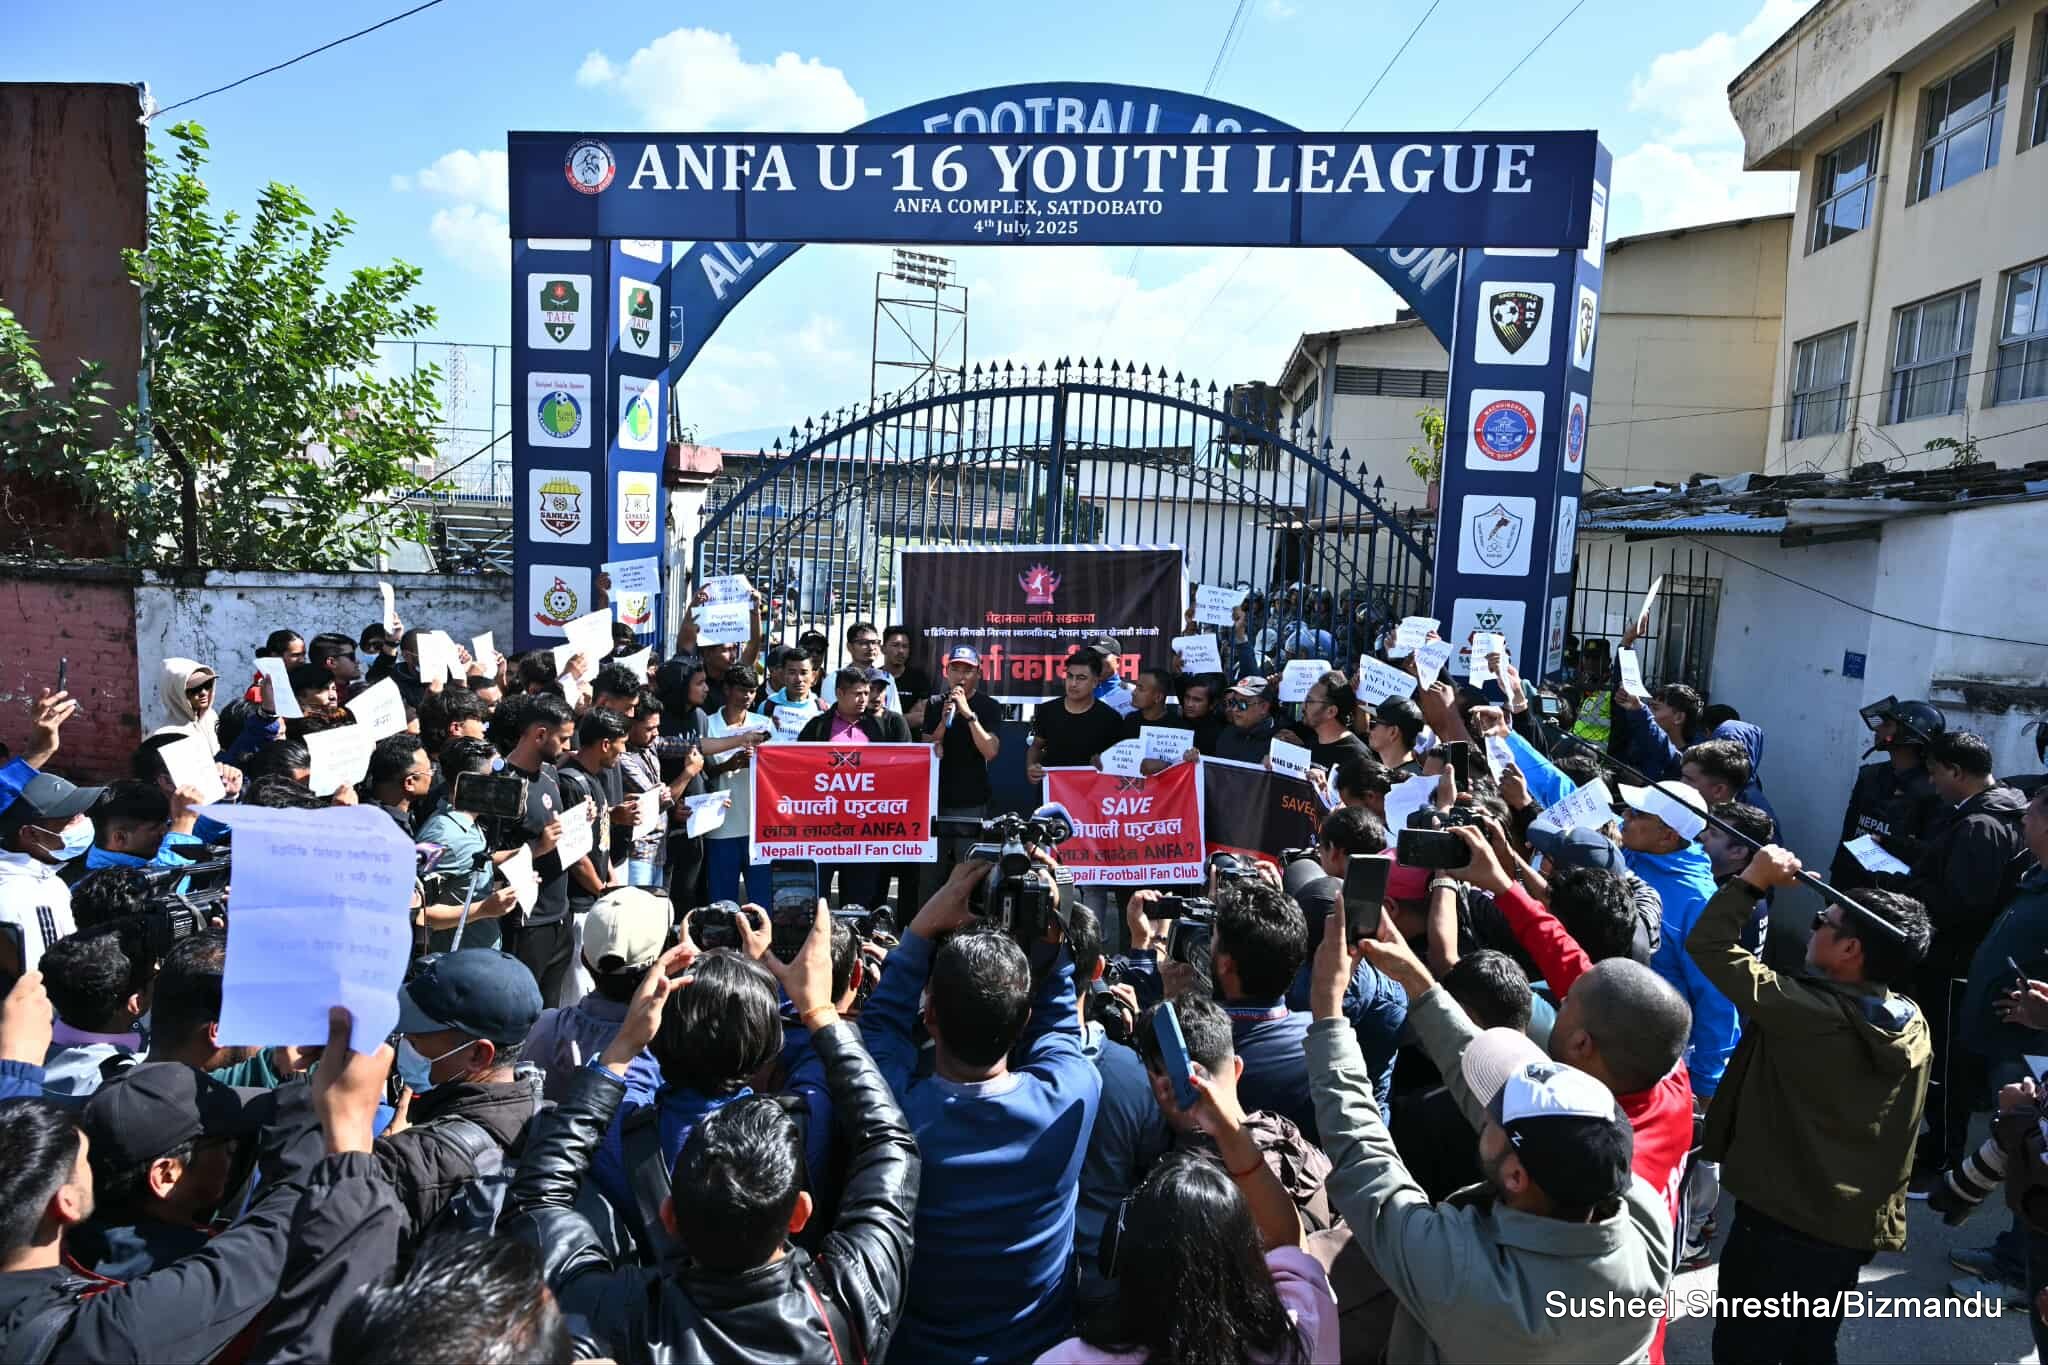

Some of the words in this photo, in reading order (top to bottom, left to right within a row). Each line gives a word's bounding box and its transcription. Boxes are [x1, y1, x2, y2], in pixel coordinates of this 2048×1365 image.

[628, 144, 796, 191] ANFA
[817, 144, 968, 192] U-16
[990, 145, 1230, 194] YOUTH
[1254, 144, 1535, 193] LEAGUE
[893, 198, 942, 213] ANFA
[947, 198, 1042, 217] COMPLEX,
[1046, 199, 1163, 215] SATDOBATO
[997, 219, 1031, 237] July,
[1035, 220, 1078, 235] 2025
[546, 311, 575, 323] TAFC
[540, 512, 580, 521] SANKATA
[814, 772, 875, 792] SAVE
[776, 794, 839, 816] नेपाली
[844, 798, 909, 819] फुटबल
[1101, 796, 1154, 816] SAVE
[1281, 795, 1313, 815] SAVE
[860, 821, 907, 837] ANFA
[911, 821, 921, 836] ?
[1858, 814, 1891, 836] NEPAL
[761, 844, 804, 858] Nepali
[807, 843, 862, 857] Football
[865, 844, 889, 856] Fan
[892, 843, 923, 856] Club
[1144, 842, 1184, 860] ANFA
[1186, 842, 1195, 857] ?
[1072, 869, 1096, 882] pali
[1100, 867, 1147, 881] Football
[1150, 867, 1170, 880] Fan
[1173, 865, 1199, 879] Club
